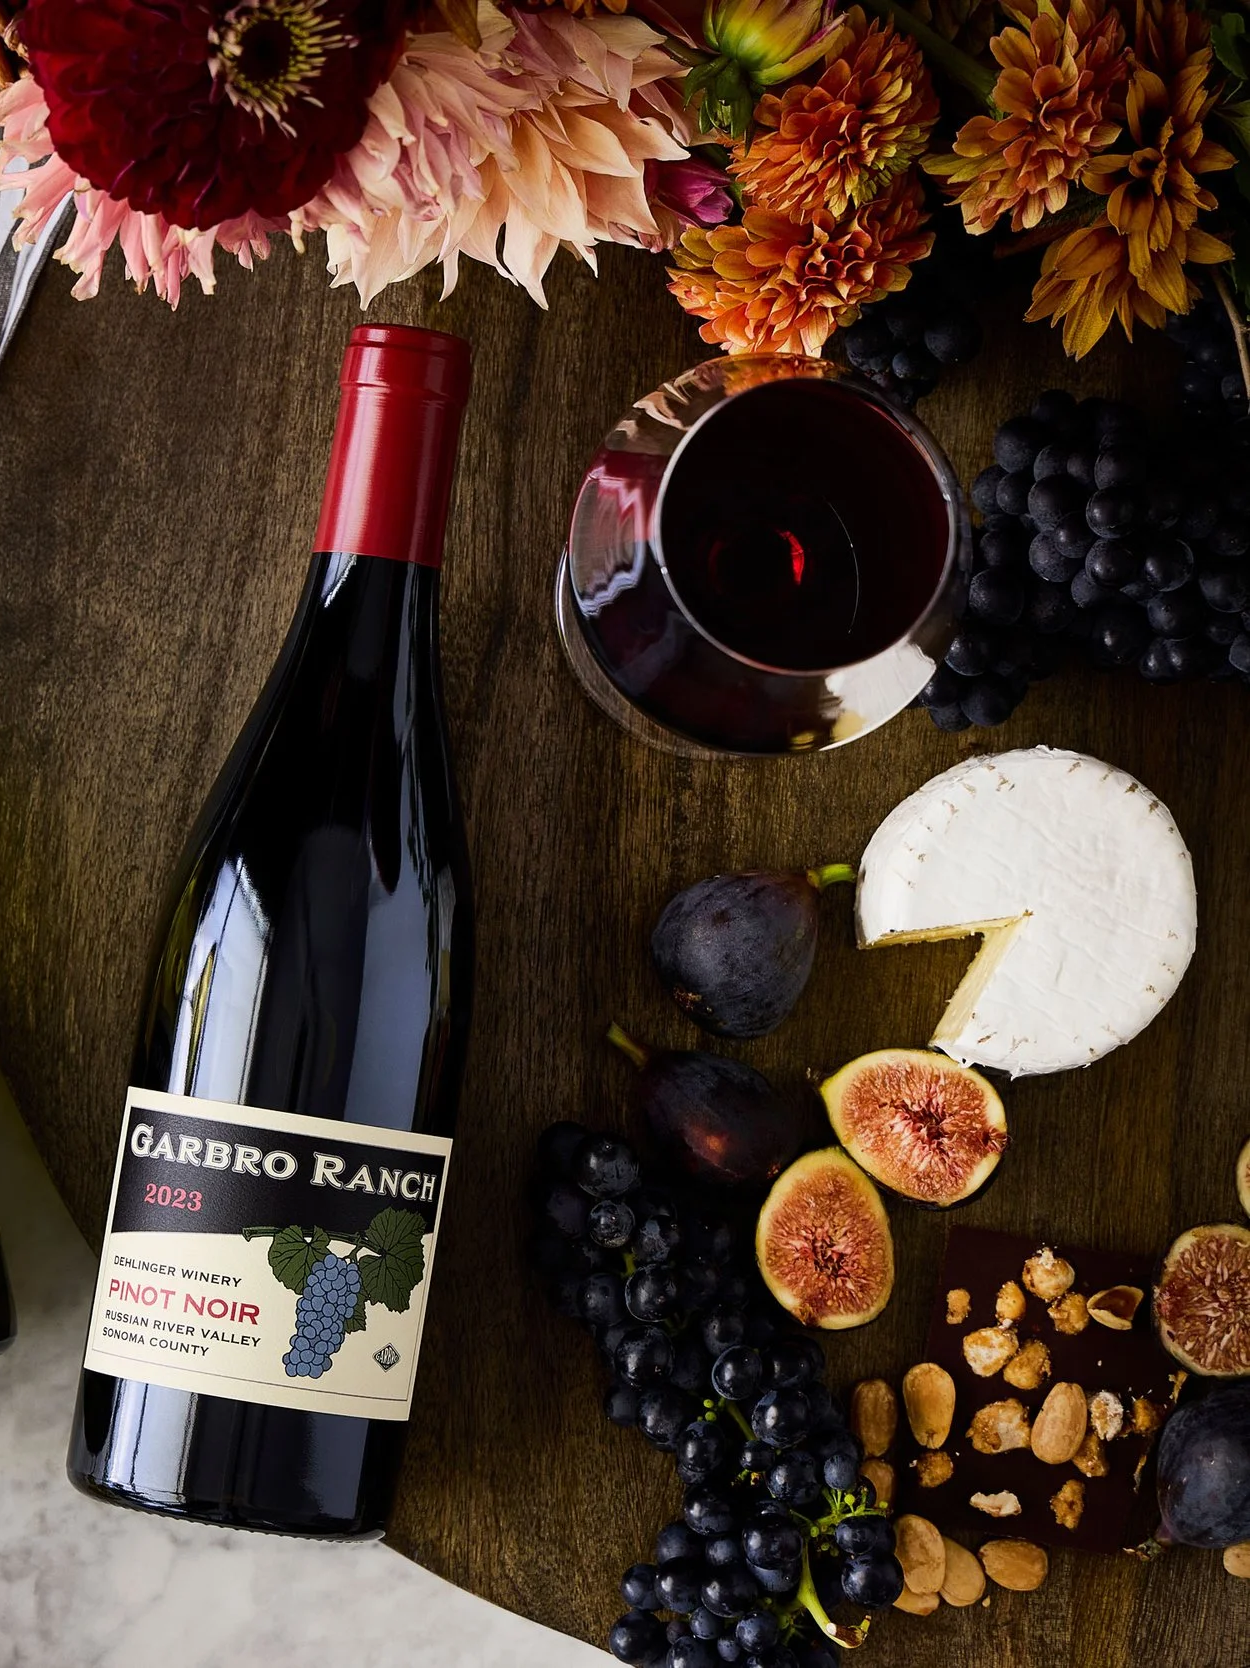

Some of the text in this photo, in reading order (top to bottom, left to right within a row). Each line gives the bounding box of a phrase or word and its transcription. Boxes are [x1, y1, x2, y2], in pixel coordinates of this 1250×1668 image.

[131, 1123, 436, 1201] GARBRO RANCH
[144, 1184, 202, 1212] 2023
[114, 1256, 242, 1288] DEHLINGER WINERY
[108, 1279, 260, 1325] PINOT NOIR
[103, 1327, 209, 1356] SONOMA COUNTY
[105, 1310, 261, 1347] RUSSIAN RIVER VALLEY
